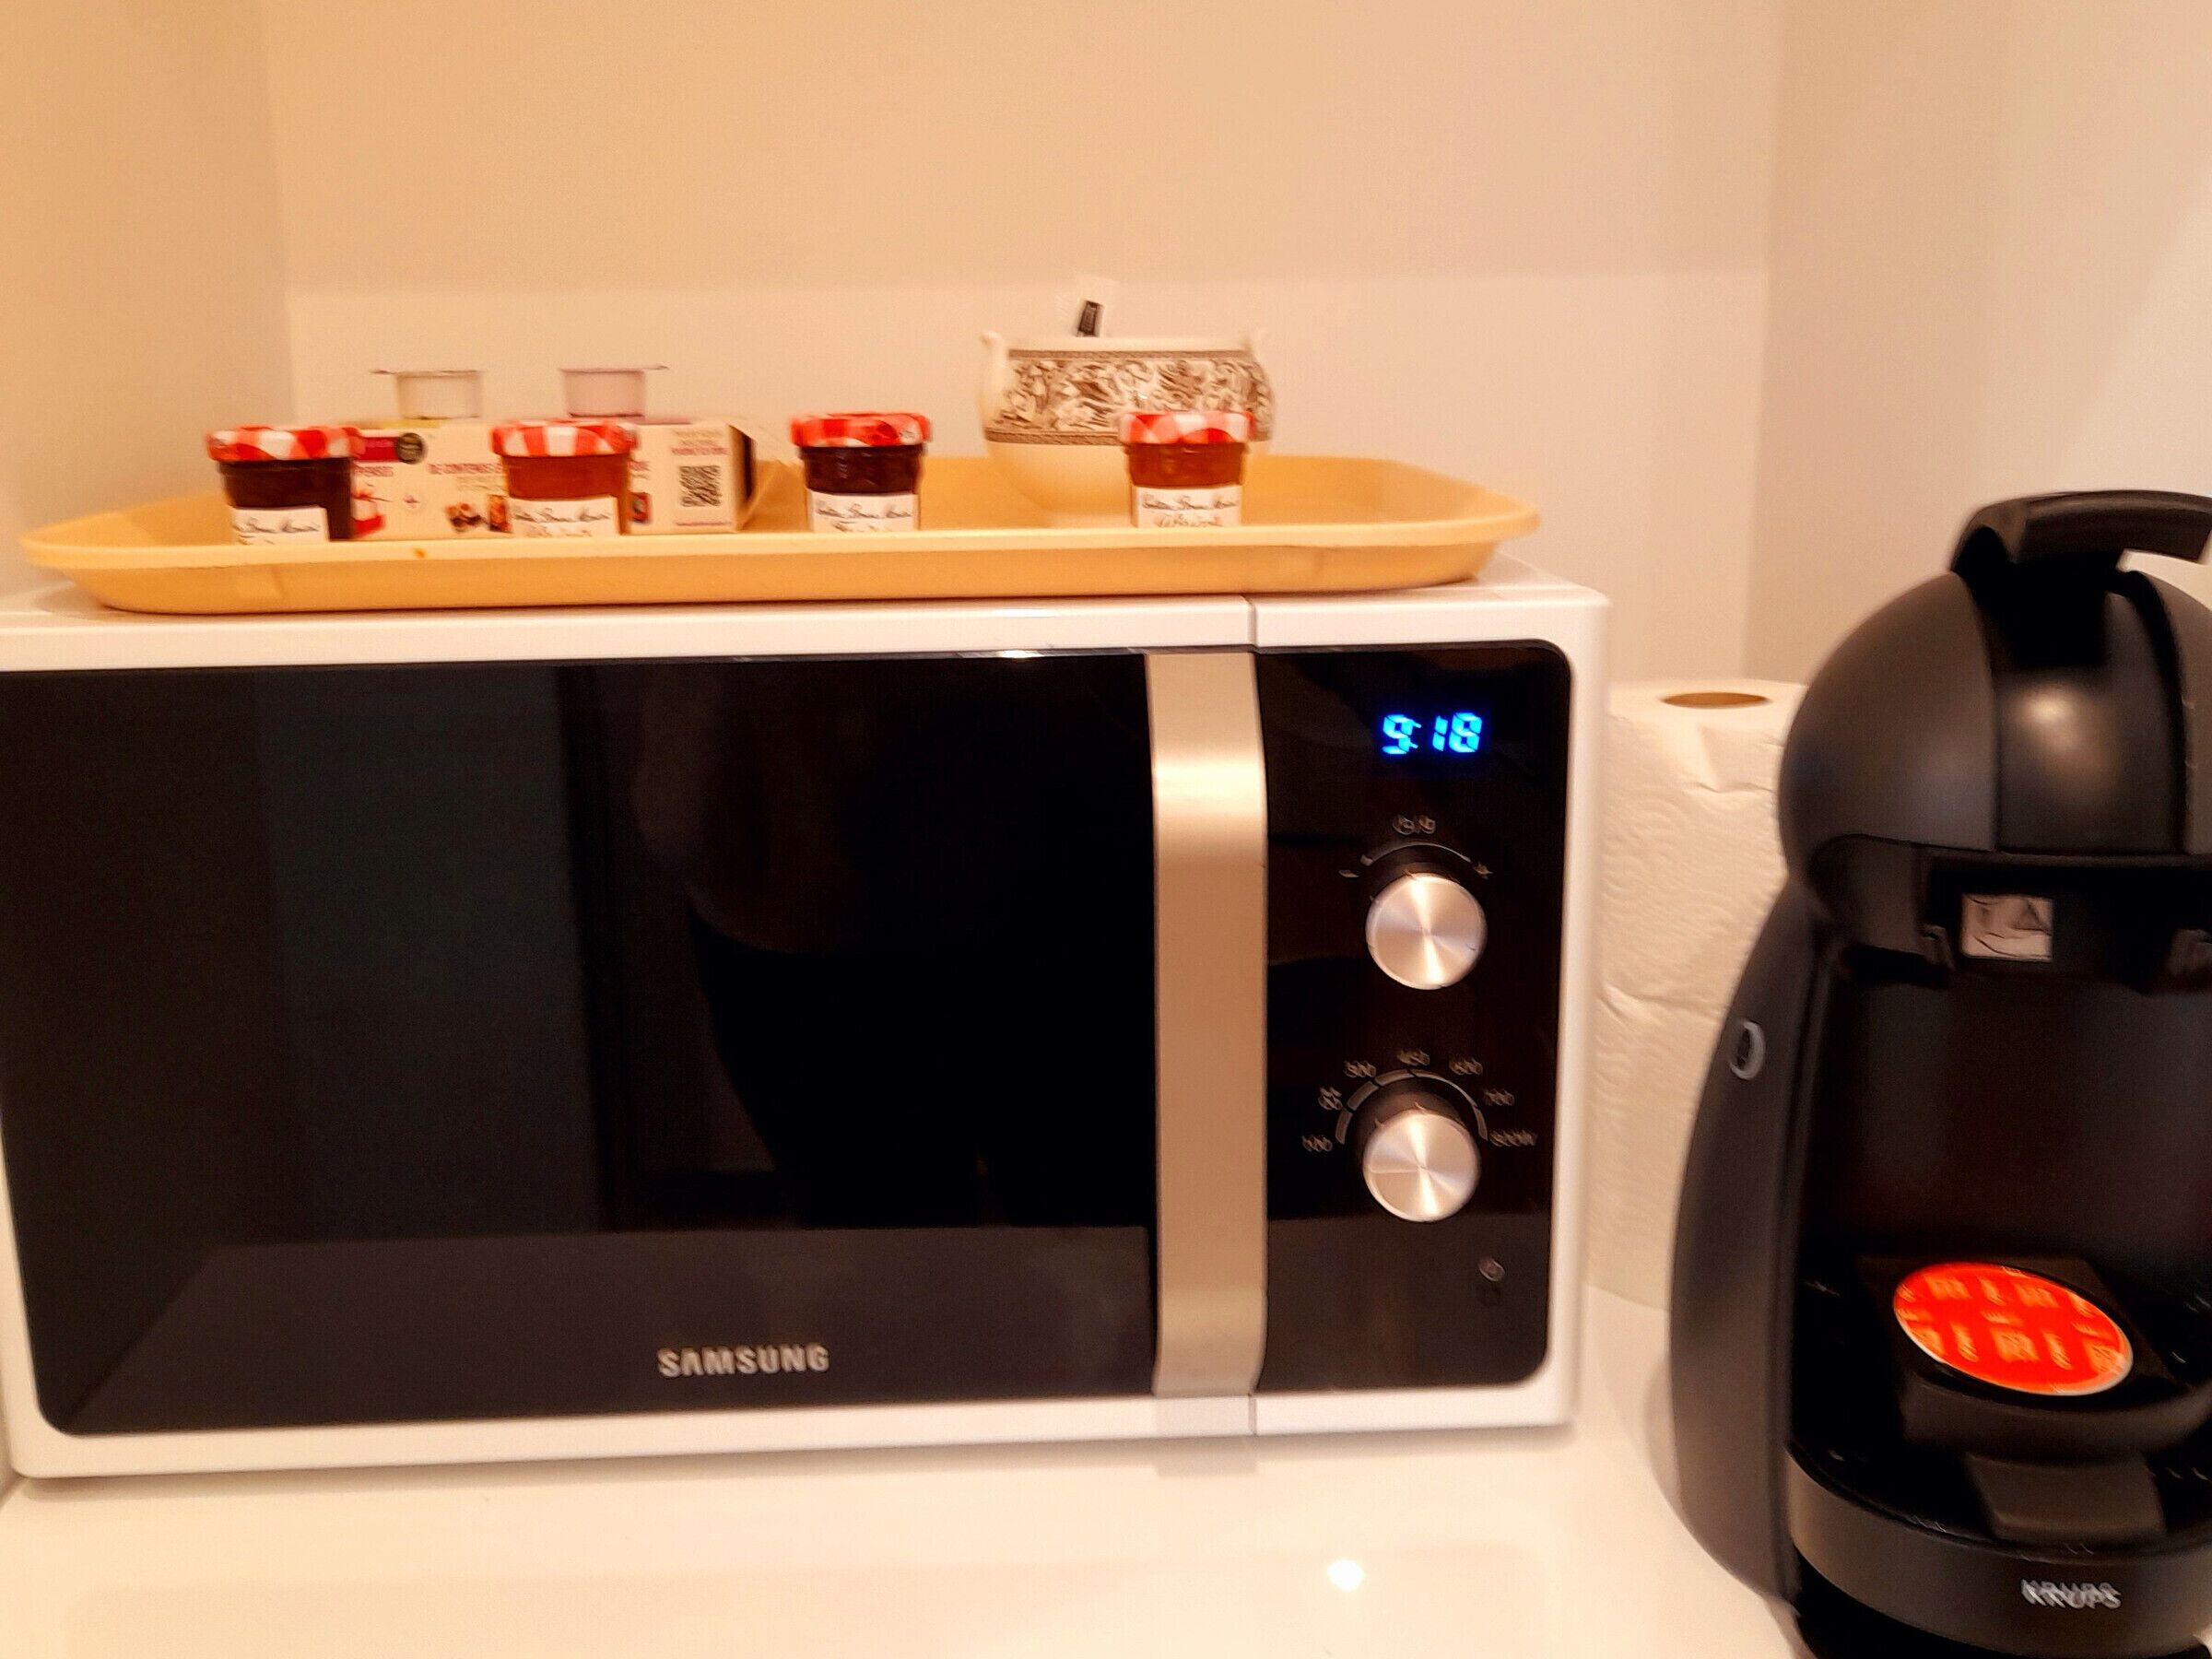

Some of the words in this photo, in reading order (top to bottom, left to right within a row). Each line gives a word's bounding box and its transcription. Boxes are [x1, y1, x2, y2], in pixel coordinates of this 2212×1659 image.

[1382, 712, 1483, 755] 9:18
[657, 1342, 830, 1378] SAMSUNG
[2019, 1578, 2122, 1609] KRUPS
